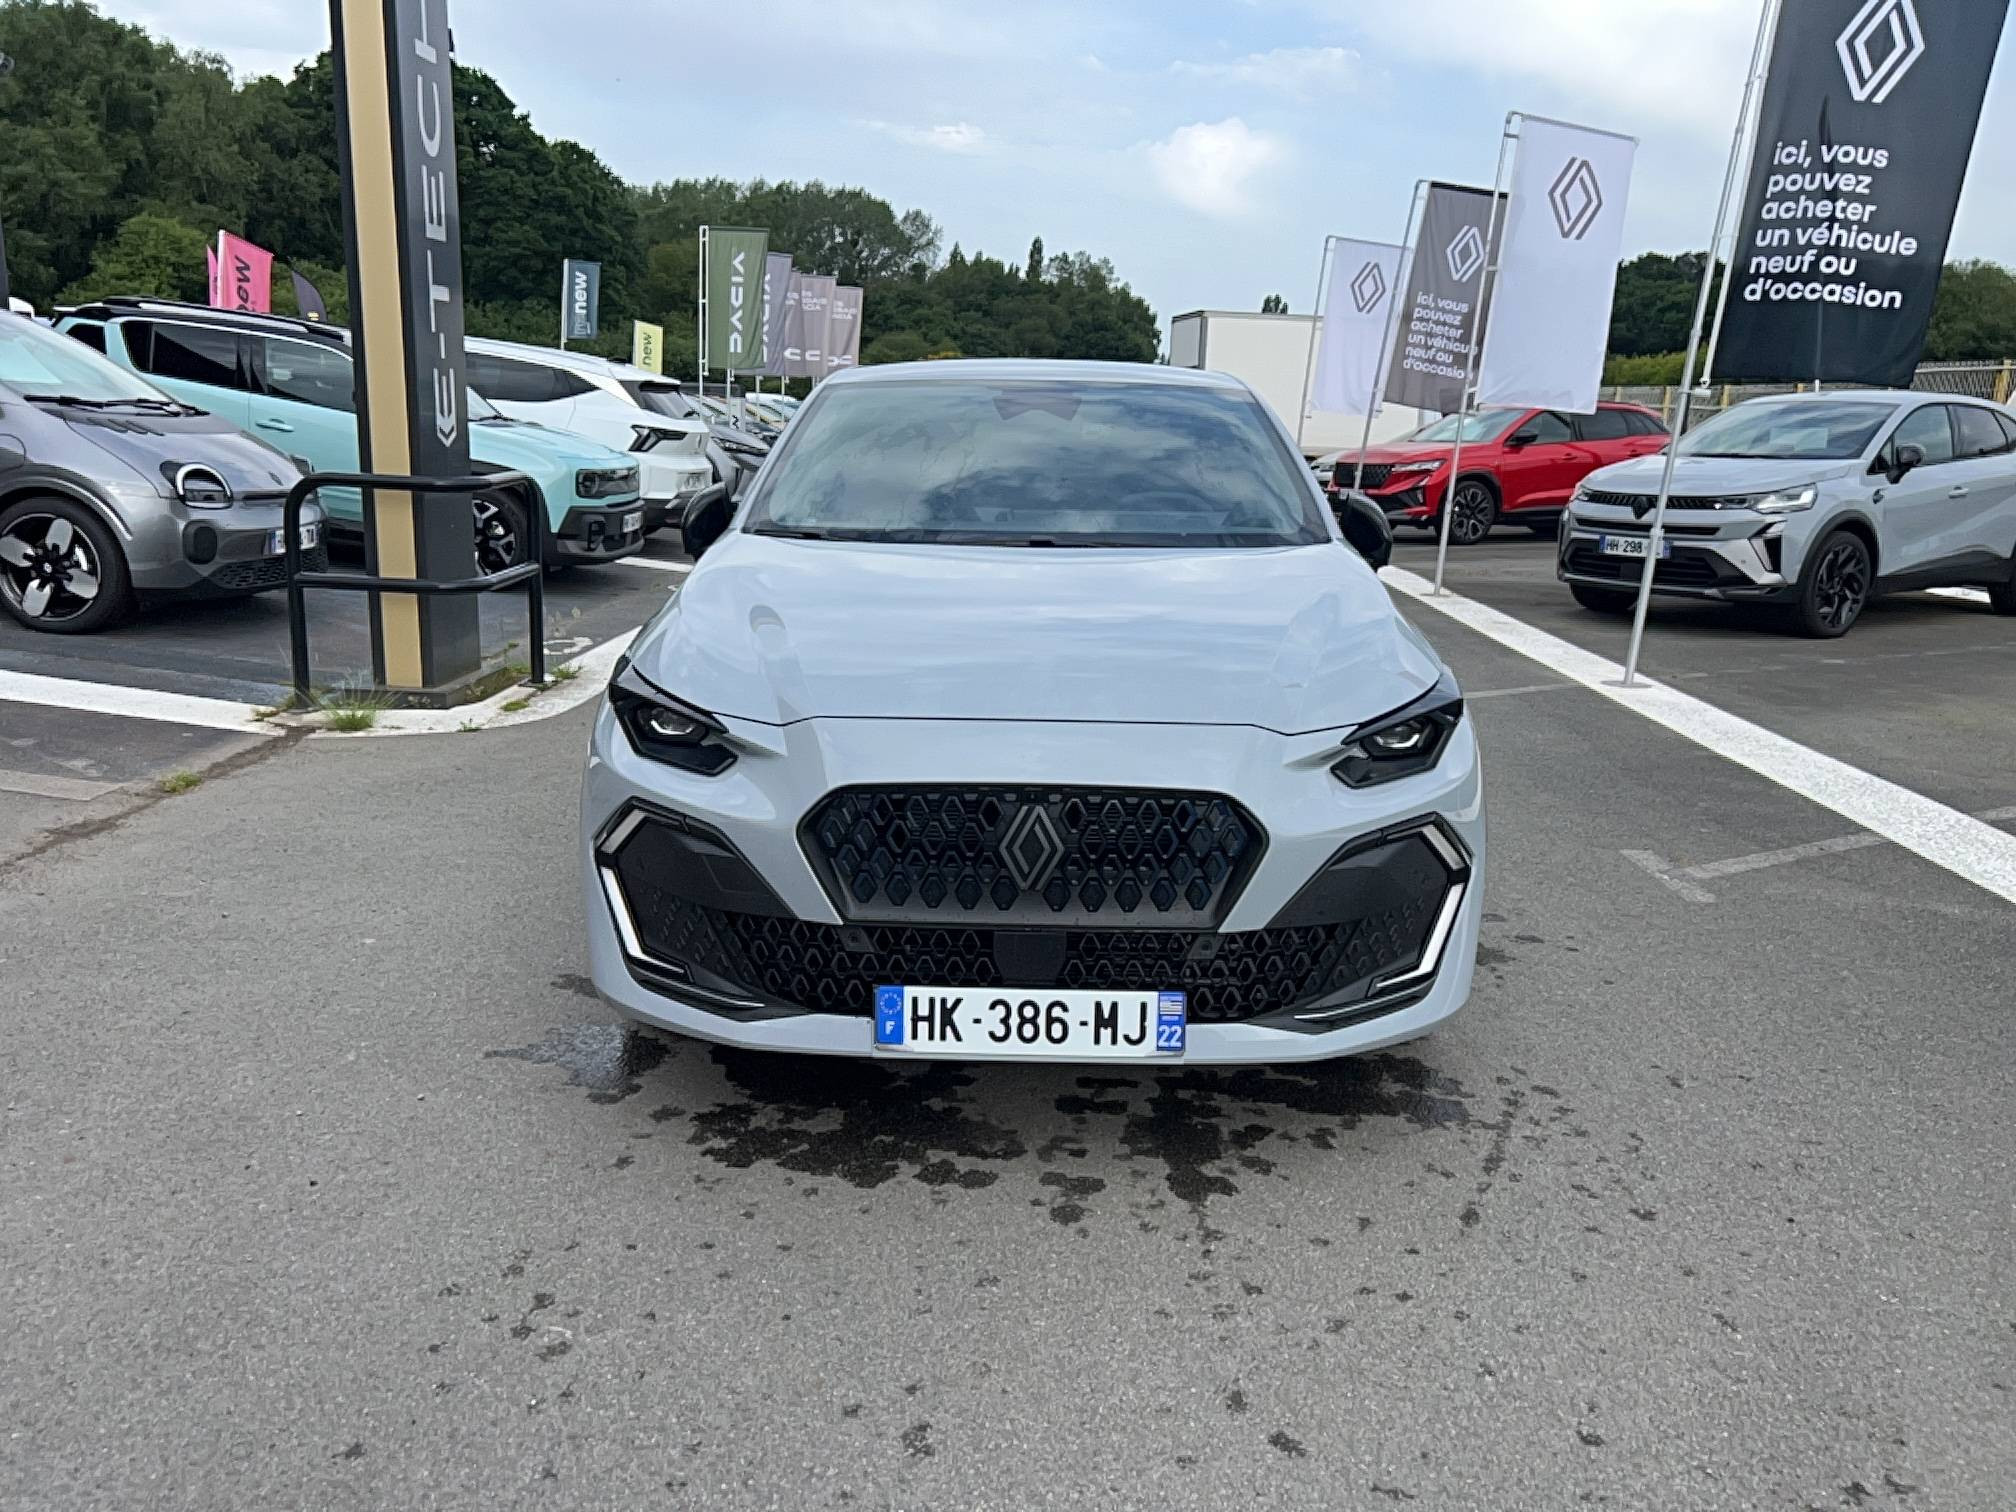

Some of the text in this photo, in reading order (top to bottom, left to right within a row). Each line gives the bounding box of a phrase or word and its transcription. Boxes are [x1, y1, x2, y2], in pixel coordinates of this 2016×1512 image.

[1773, 139, 1890, 168] ici, vous
[1766, 172, 1873, 199] pouvez
[1761, 195, 1877, 223] acheter
[415, 0, 457, 446] E-TECH
[1755, 222, 1918, 256] un véhicule
[1749, 249, 1857, 275] neuf ou
[729, 251, 745, 353] DACIA
[1416, 291, 1469, 313] ici, vous
[1743, 277, 1902, 309] d'occasion
[1413, 307, 1462, 325] pouvez
[1411, 320, 1464, 339] acheter
[1405, 346, 1453, 363] neuf ou
[1408, 333, 1478, 354] un véhicu
[1403, 357, 1472, 379] d'occasio
[884, 1021, 896, 1035] F
[910, 996, 1148, 1046] HK-386-MJ
[1158, 1025, 1182, 1047] 22
